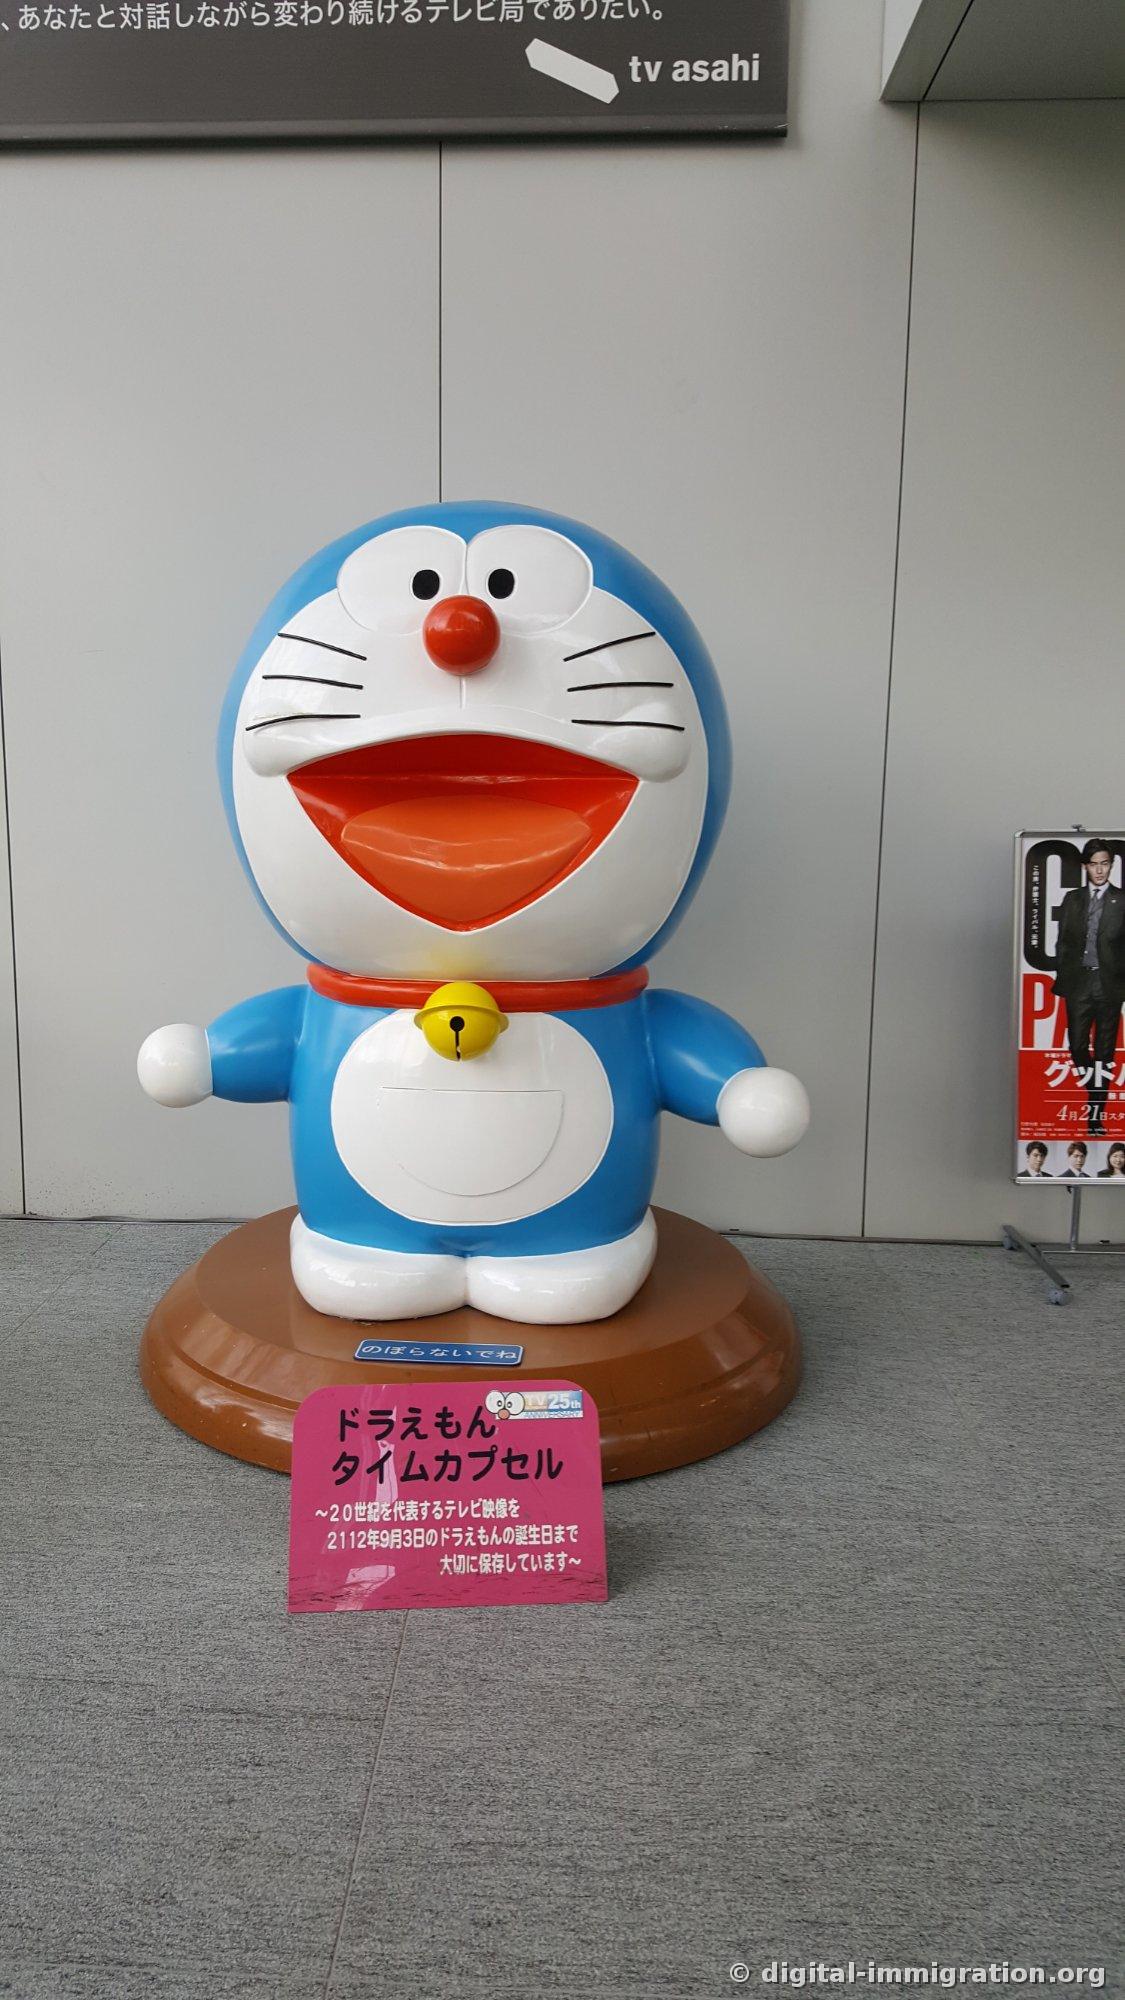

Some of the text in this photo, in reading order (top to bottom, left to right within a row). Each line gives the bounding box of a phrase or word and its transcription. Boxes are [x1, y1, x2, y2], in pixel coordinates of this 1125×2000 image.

[629, 53, 760, 83] tv asahi
[362, 1345, 518, 1359] のぼらないでね
[548, 1392, 581, 1409] 25th
[339, 1406, 496, 1442] ドラえもん
[332, 1446, 563, 1486] タイムカプセル
[327, 1524, 579, 1550] 2112年9月3日のドラえもんの誕生日まで
